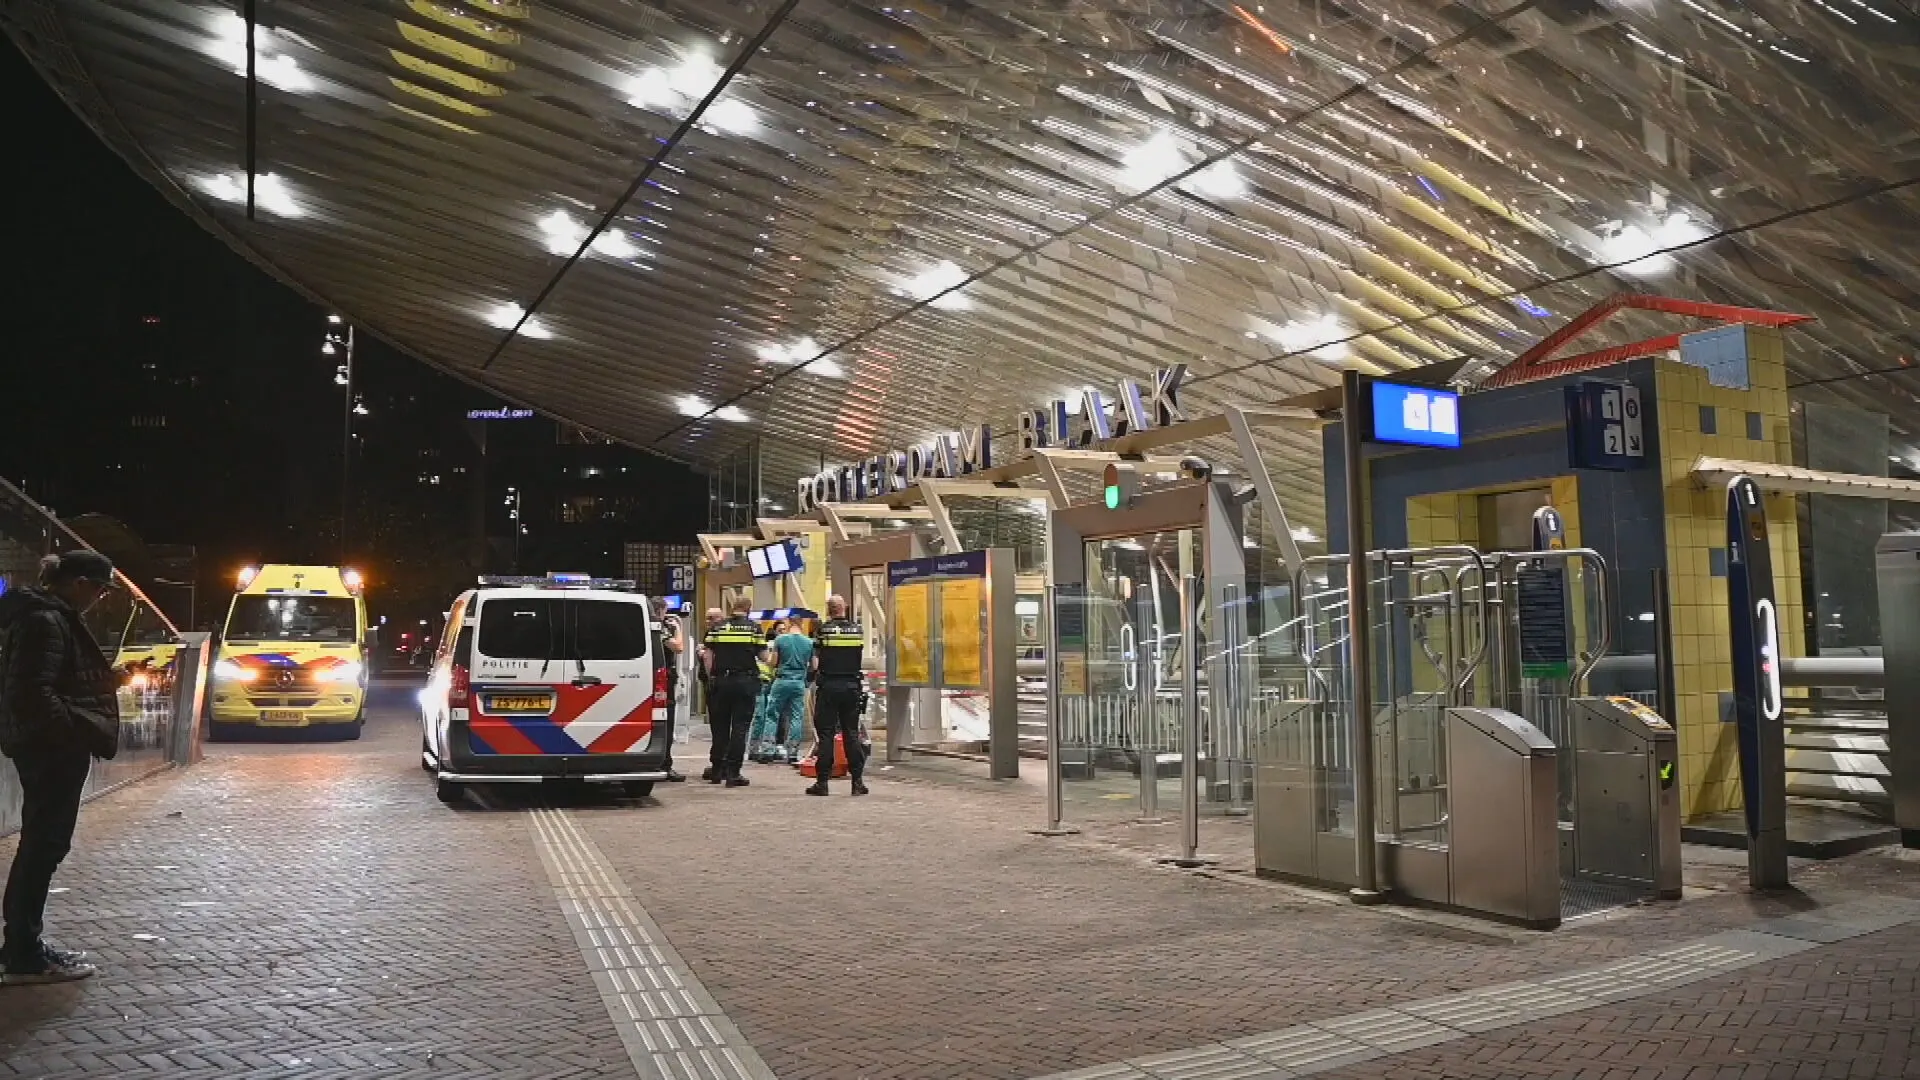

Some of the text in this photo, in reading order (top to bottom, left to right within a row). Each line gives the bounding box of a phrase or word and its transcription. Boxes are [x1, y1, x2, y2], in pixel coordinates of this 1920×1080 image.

[1607, 399, 1614, 417] 1
[797, 363, 1188, 514] ROTTERDAM BLAAK
[1609, 435, 1619, 453] 2
